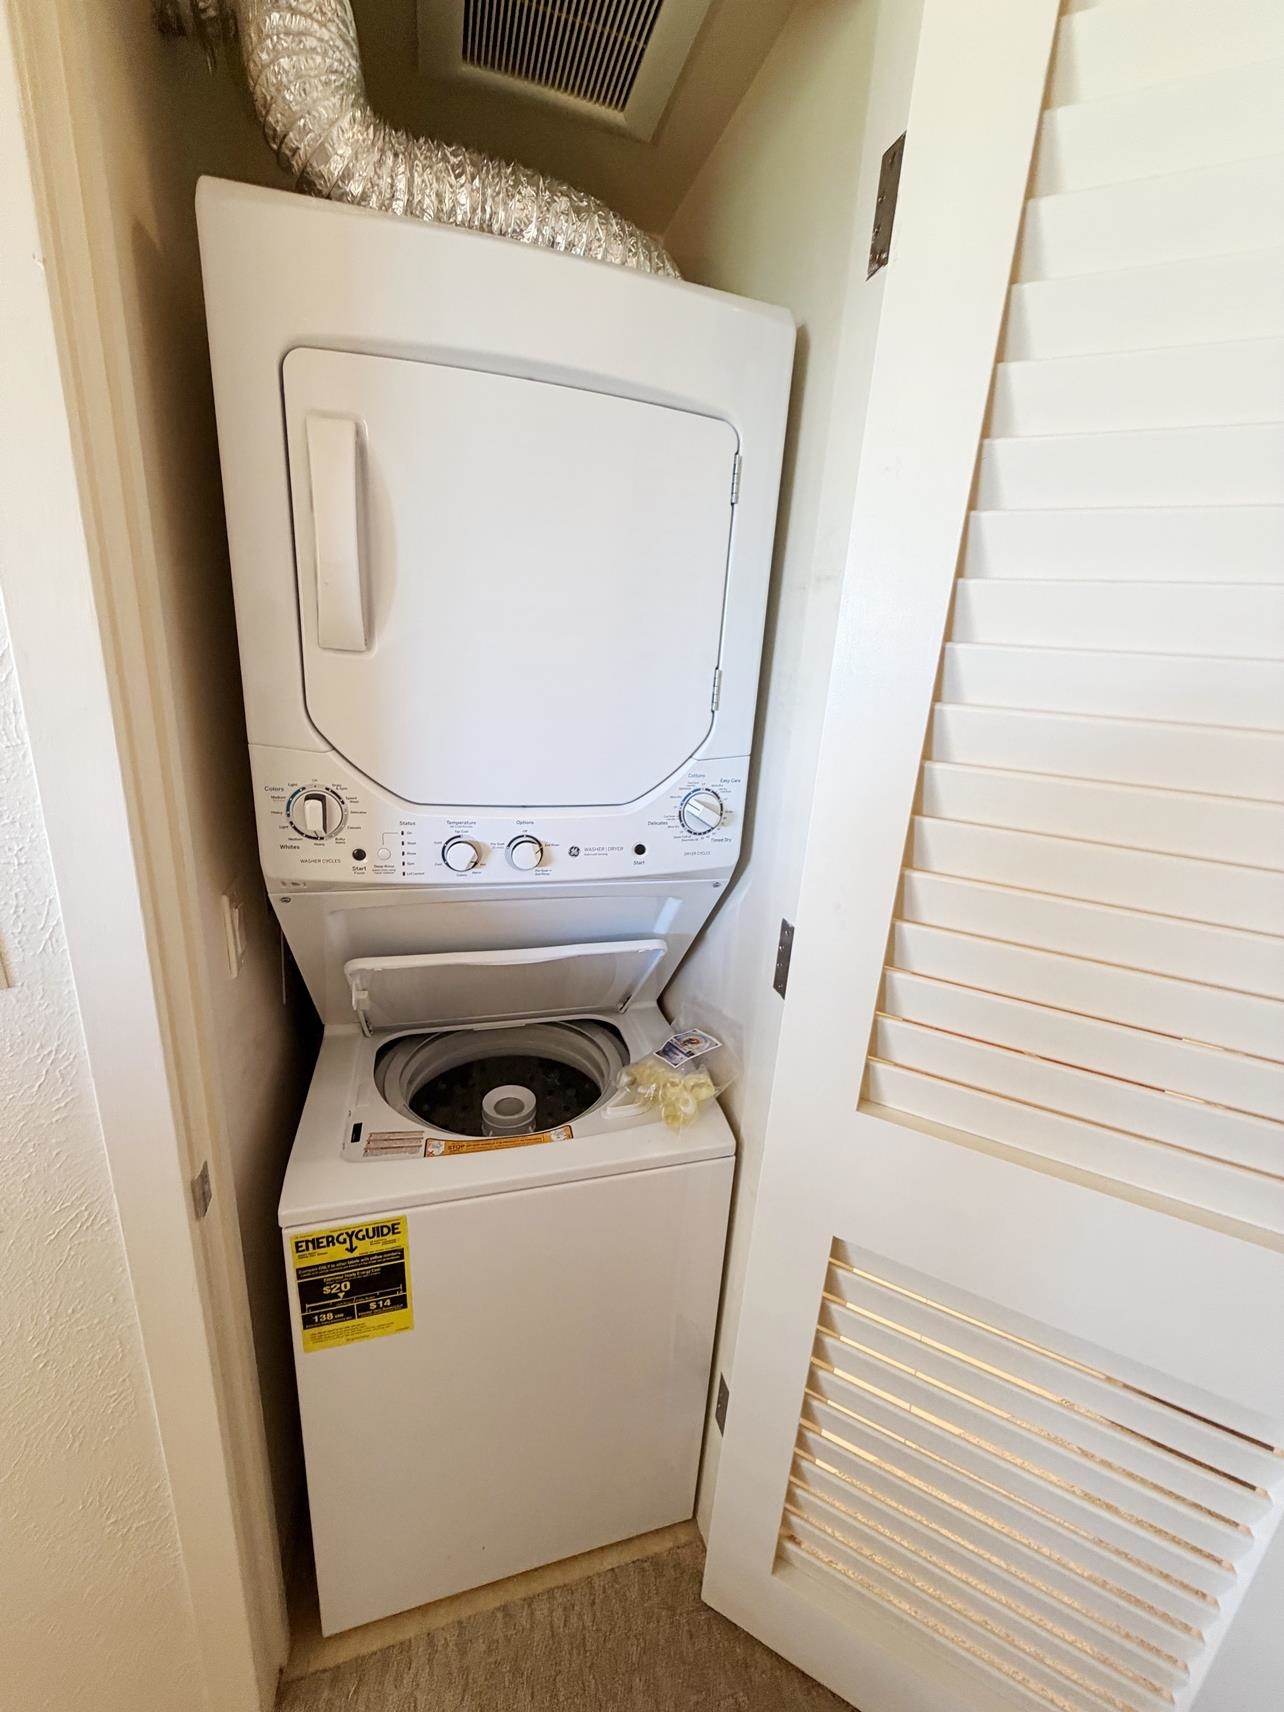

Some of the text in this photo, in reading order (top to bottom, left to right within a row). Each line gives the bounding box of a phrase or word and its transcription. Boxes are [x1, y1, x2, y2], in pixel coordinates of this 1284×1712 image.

[448, 1143, 466, 1152] STOP
[294, 1222, 401, 1254] ENERGYGUIDE
[322, 1281, 351, 1295] $20
[369, 1299, 392, 1310] $14
[312, 1312, 334, 1323] 138
